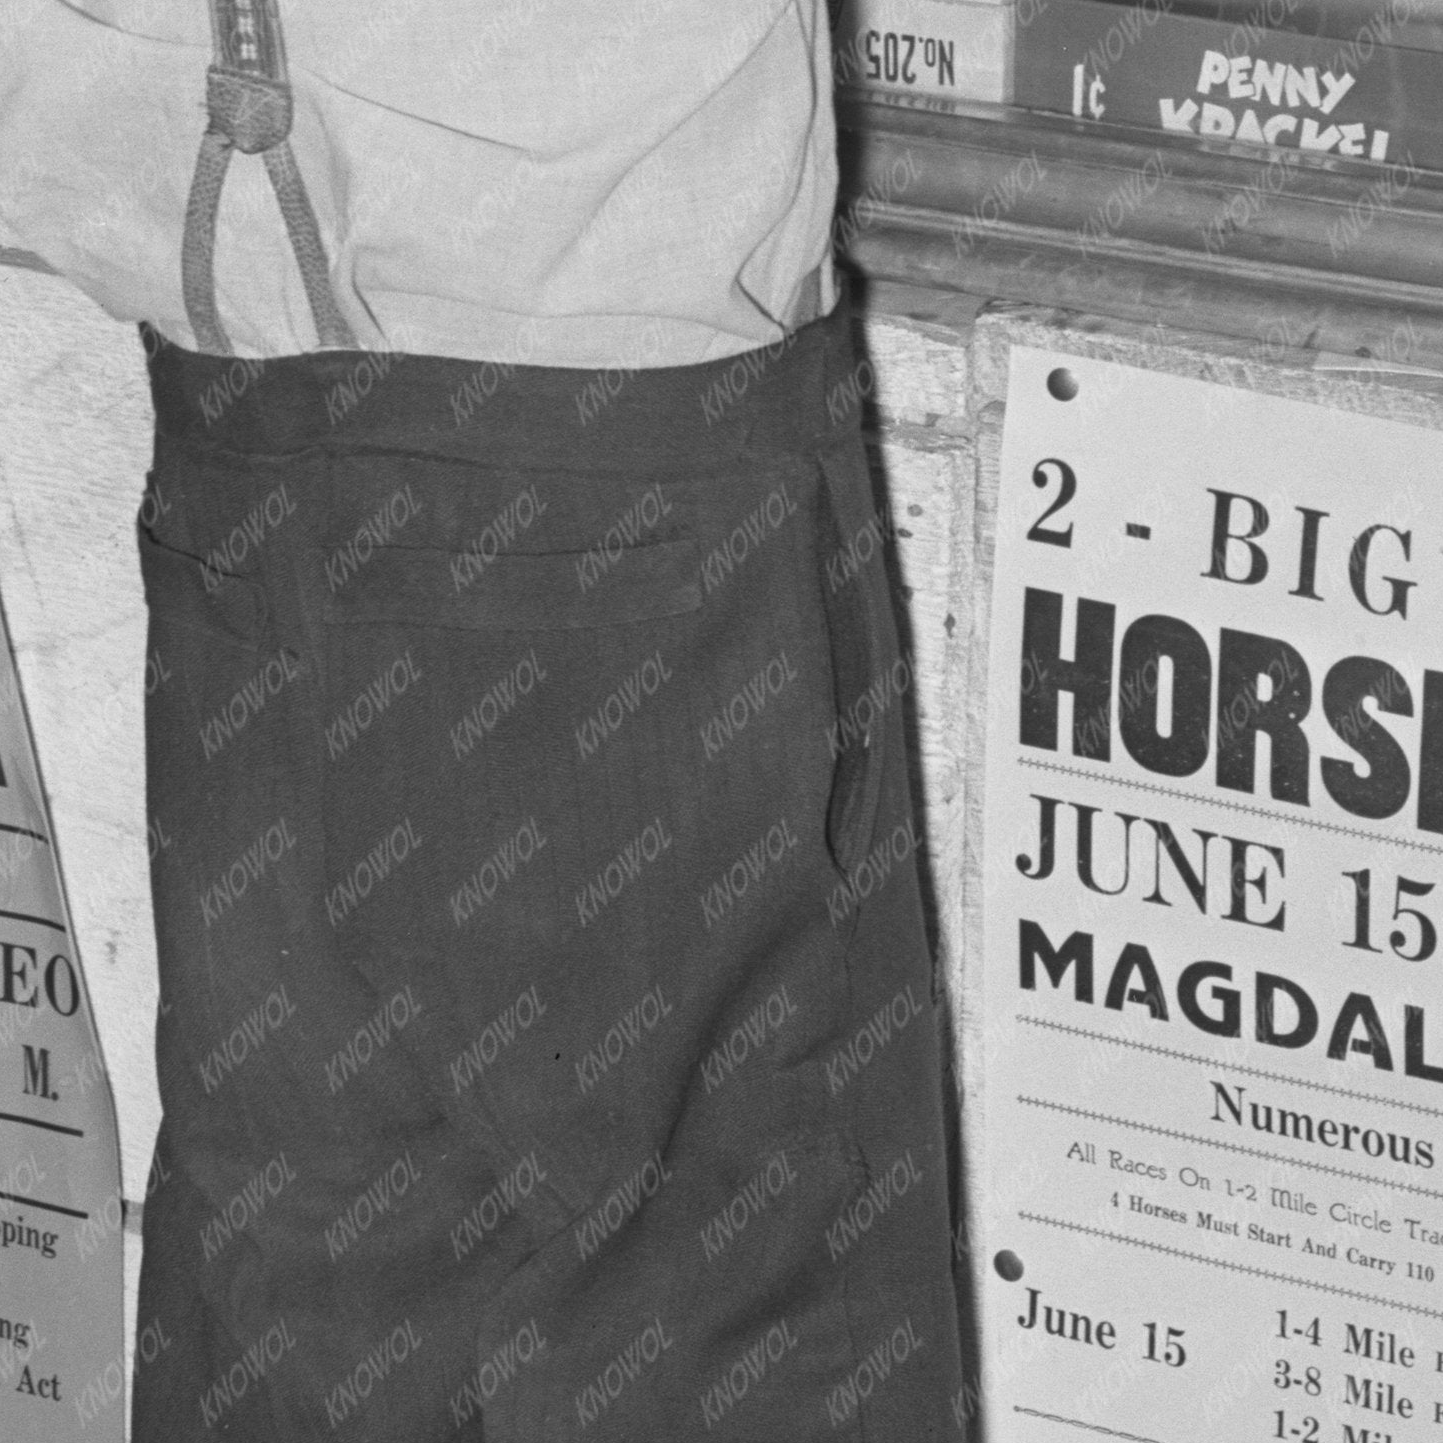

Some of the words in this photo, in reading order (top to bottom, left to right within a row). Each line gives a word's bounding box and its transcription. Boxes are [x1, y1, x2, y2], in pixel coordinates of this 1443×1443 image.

[1196, 49, 1357, 114] PENNY
[1025, 456, 1078, 550] 2
[1199, 487, 1417, 622] BIG
[1013, 791, 1289, 932] JUNE
[1337, 866, 1439, 962] 15
[1066, 1139, 1097, 1165] All
[1108, 1148, 1168, 1181] Races
[1209, 1080, 1436, 1170] Numerous
[1016, 1286, 1118, 1351] June
[1141, 1320, 1188, 1369] 15
[1343, 1322, 1417, 1369] Mile
